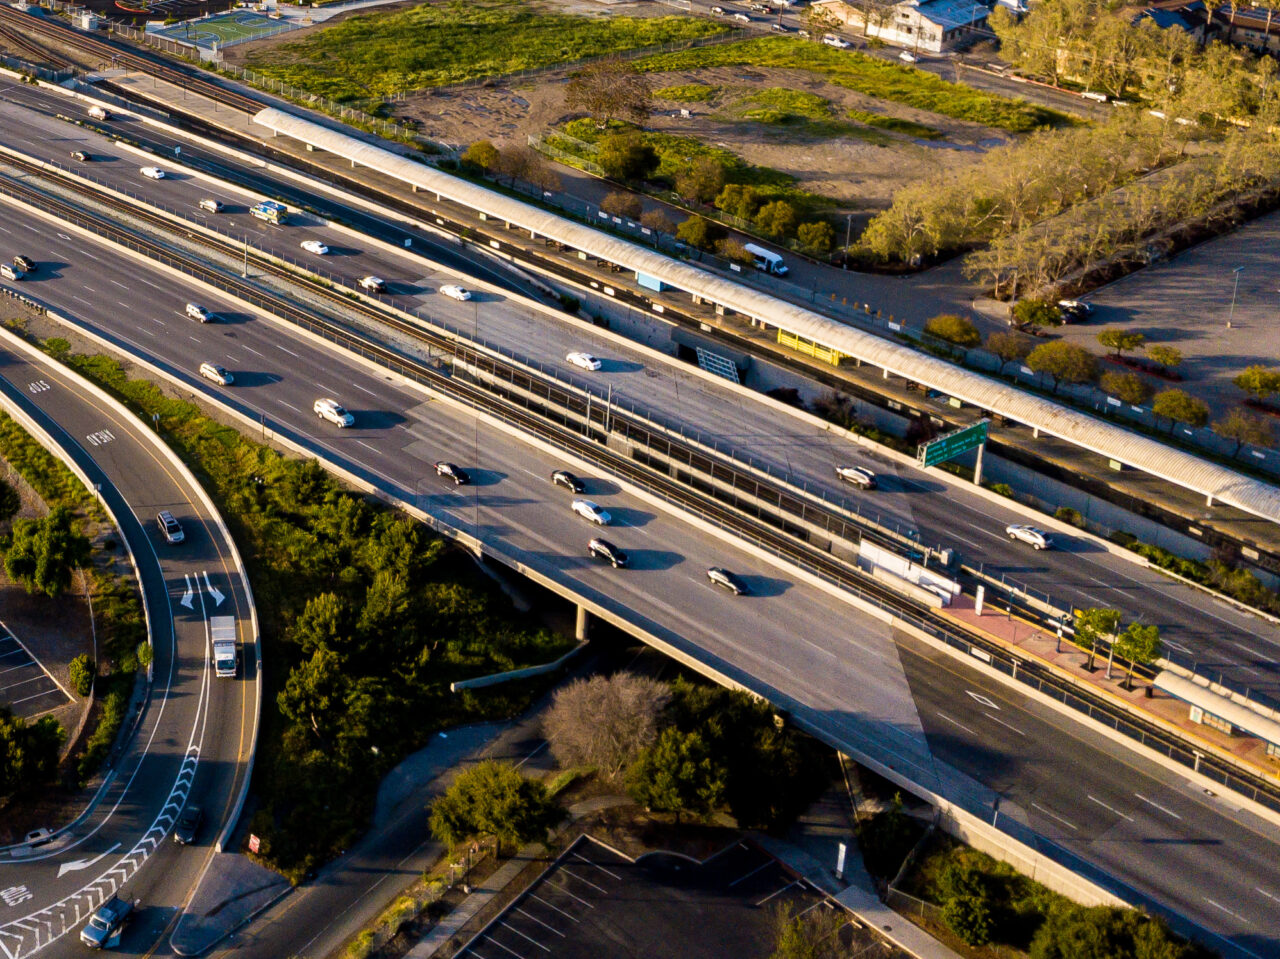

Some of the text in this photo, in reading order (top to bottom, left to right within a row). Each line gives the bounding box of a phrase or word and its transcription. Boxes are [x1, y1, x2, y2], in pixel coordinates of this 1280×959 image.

[28, 380, 50, 393] STOP
[86, 429, 115, 445] AHEAD
[0, 885, 33, 906] STOP
